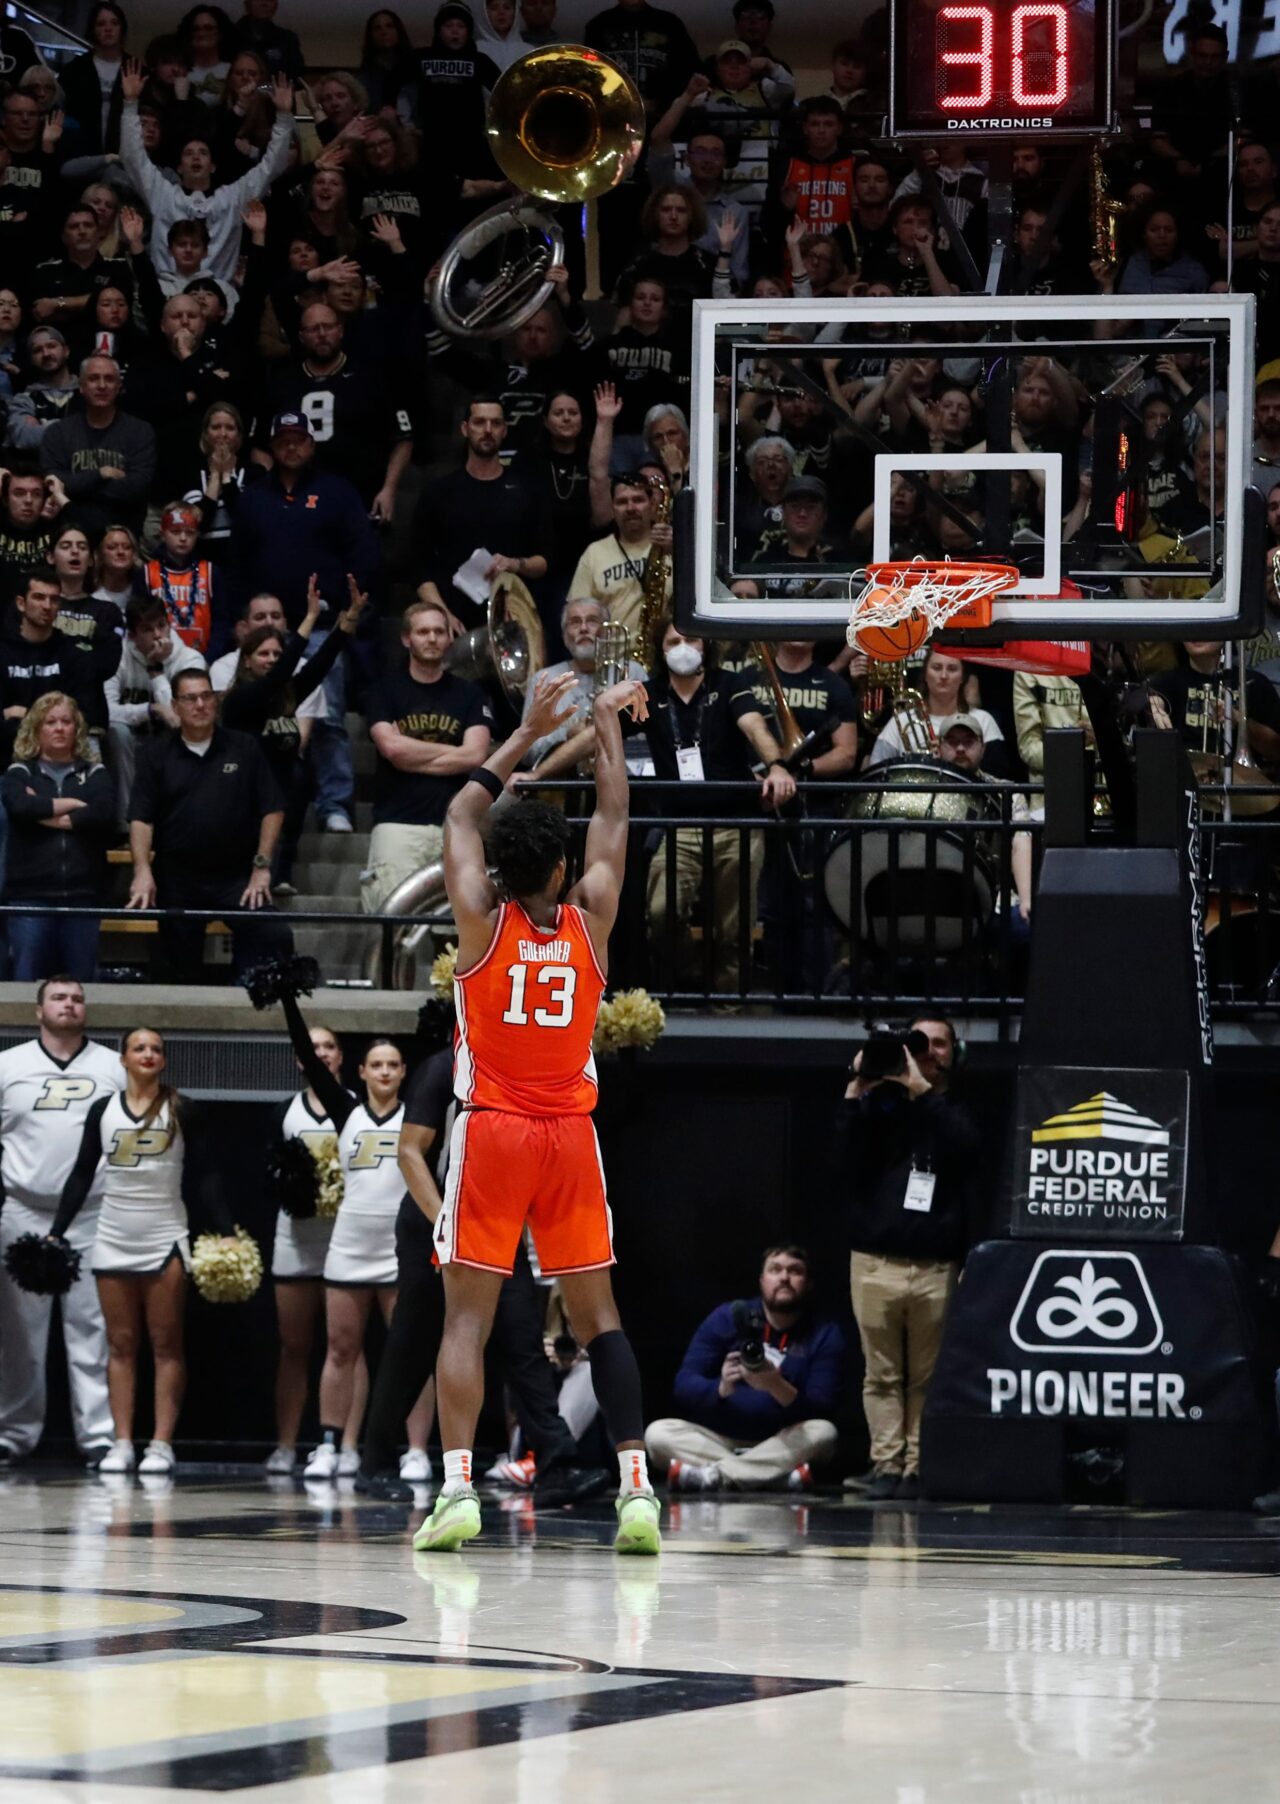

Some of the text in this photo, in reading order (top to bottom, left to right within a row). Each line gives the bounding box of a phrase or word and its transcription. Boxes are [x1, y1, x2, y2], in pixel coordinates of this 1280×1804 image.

[423, 60, 474, 76] PURDUE
[940, 4, 1068, 109] 30
[947, 118, 1052, 129] DAKTRONICS
[809, 199, 833, 218] 20
[300, 390, 335, 442] 9
[395, 409, 411, 431] 9
[751, 686, 828, 711] PUDUE
[1045, 689, 1082, 706] PURD
[399, 713, 461, 735] PURDUE
[517, 939, 572, 964] GUERRIER
[502, 964, 577, 1027] 13
[1030, 1148, 1169, 1178] PURDUE
[1028, 1176, 1167, 1204] FEDERAL
[1027, 1200, 1167, 1221] CREDIT UNION
[987, 1368, 1186, 1419] PIONEER
